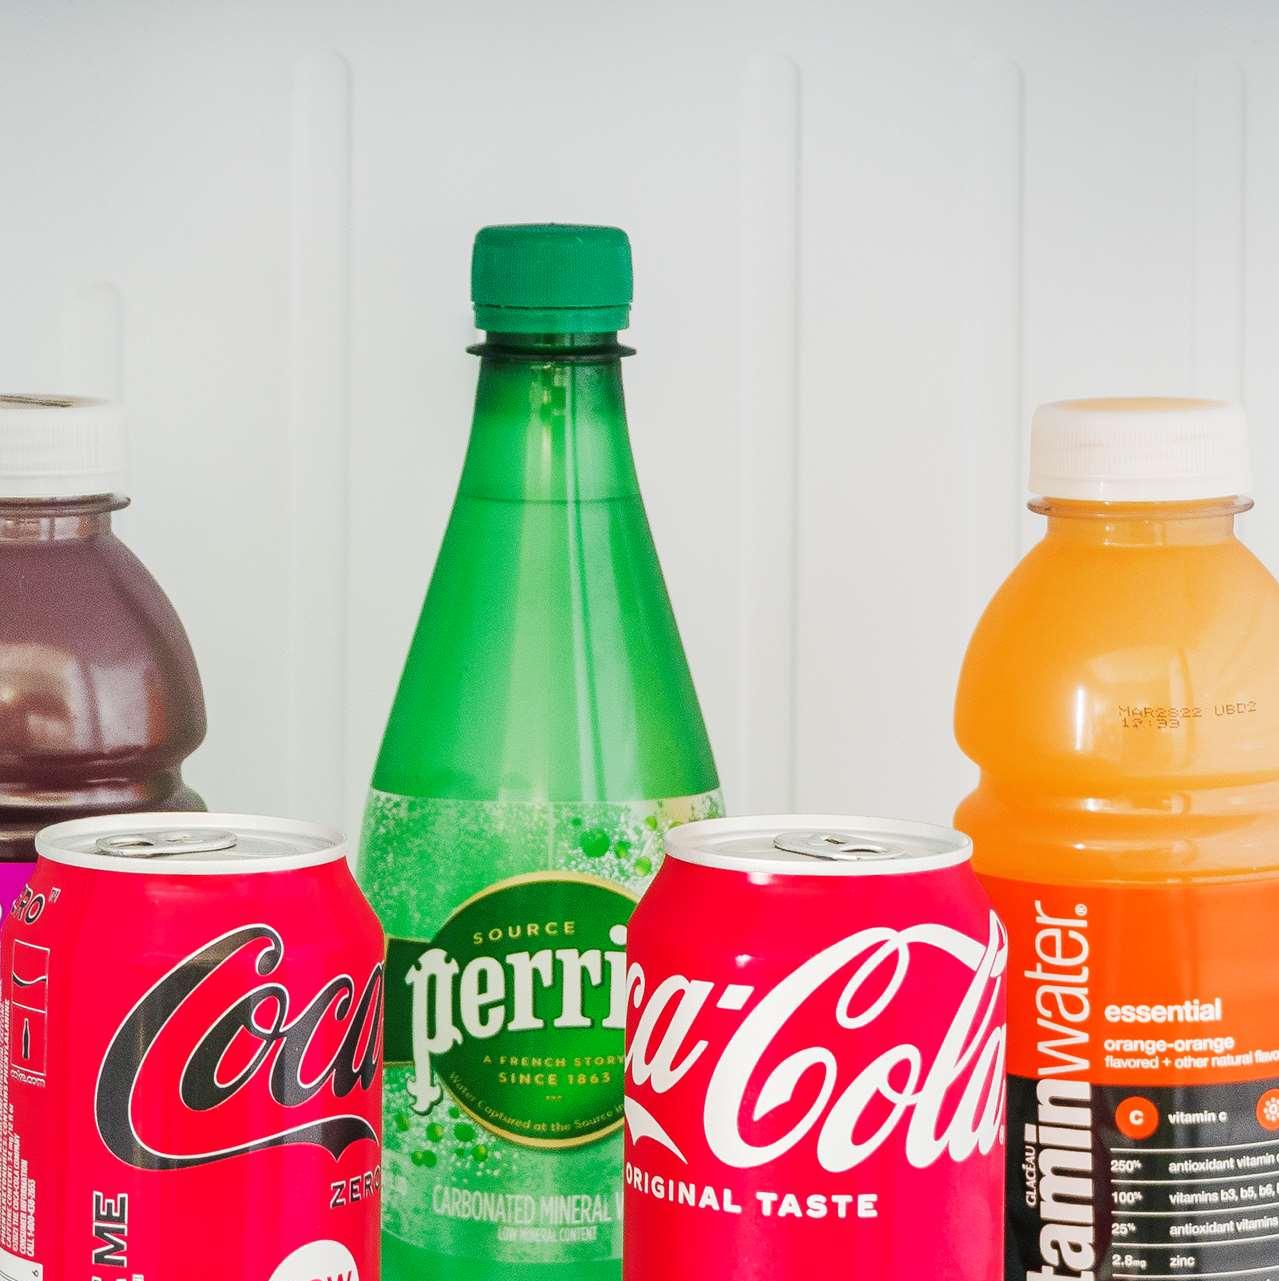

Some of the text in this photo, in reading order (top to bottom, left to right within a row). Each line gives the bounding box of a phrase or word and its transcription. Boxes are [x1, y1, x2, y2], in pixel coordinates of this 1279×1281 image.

[473, 921, 576, 945] SOURCE
[1104, 997, 1223, 1023] essential
[1103, 1035, 1235, 1055] orange-orange
[499, 1056, 567, 1067] FRENCH
[1104, 1055, 1159, 1069] flavored
[1162, 1058, 1171, 1067] +
[1174, 1054, 1209, 1069] other
[1211, 1051, 1253, 1067] natural
[498, 1071, 611, 1086] SINCE 1863
[1168, 1110, 1216, 1125] vitamin
[1218, 1111, 1228, 1123] c
[1110, 1153, 1275, 1174] 250% antioxidant vitamin
[626, 1163, 742, 1214] ORIGINAL
[756, 1192, 879, 1218] TASTE
[1111, 1191, 1143, 1205] 100%
[1169, 1190, 1218, 1206] vitamins
[1220, 1187, 1238, 1202] b3,
[1239, 1185, 1257, 1200] b5,
[1259, 1182, 1275, 1197] b6,
[432, 1184, 536, 1225] CARBONATED
[539, 1194, 613, 1226] MINERAL
[19, 1213, 27, 1255] CONSUMER
[92, 1191, 128, 1268] ME
[1111, 1222, 1136, 1236] 25%
[1169, 1222, 1236, 1238] antioxidant
[1236, 1215, 1278, 1232] vitamins
[27, 1238, 35, 1257] CALL
[1111, 1254, 1196, 1270] 2.8mg zinc
